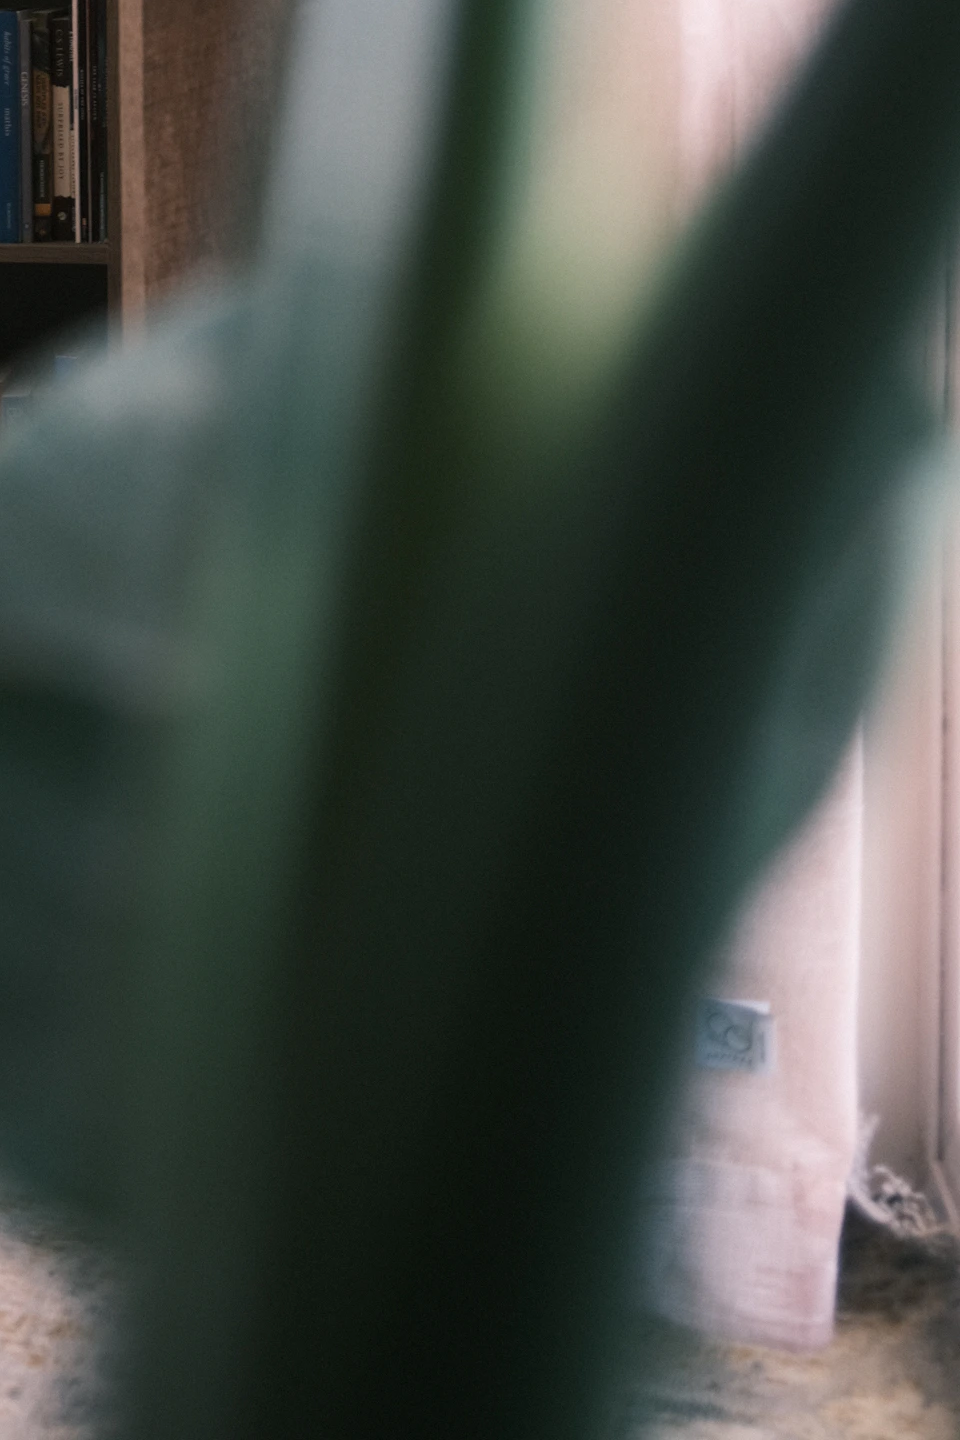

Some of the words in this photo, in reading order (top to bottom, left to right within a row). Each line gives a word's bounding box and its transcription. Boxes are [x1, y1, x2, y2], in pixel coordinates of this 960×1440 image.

[3, 31, 12, 54] habits
[56, 47, 64, 77] LEWIS
[3, 65, 11, 85] grace
[4, 108, 12, 136] mathis
[58, 152, 64, 162] BY
